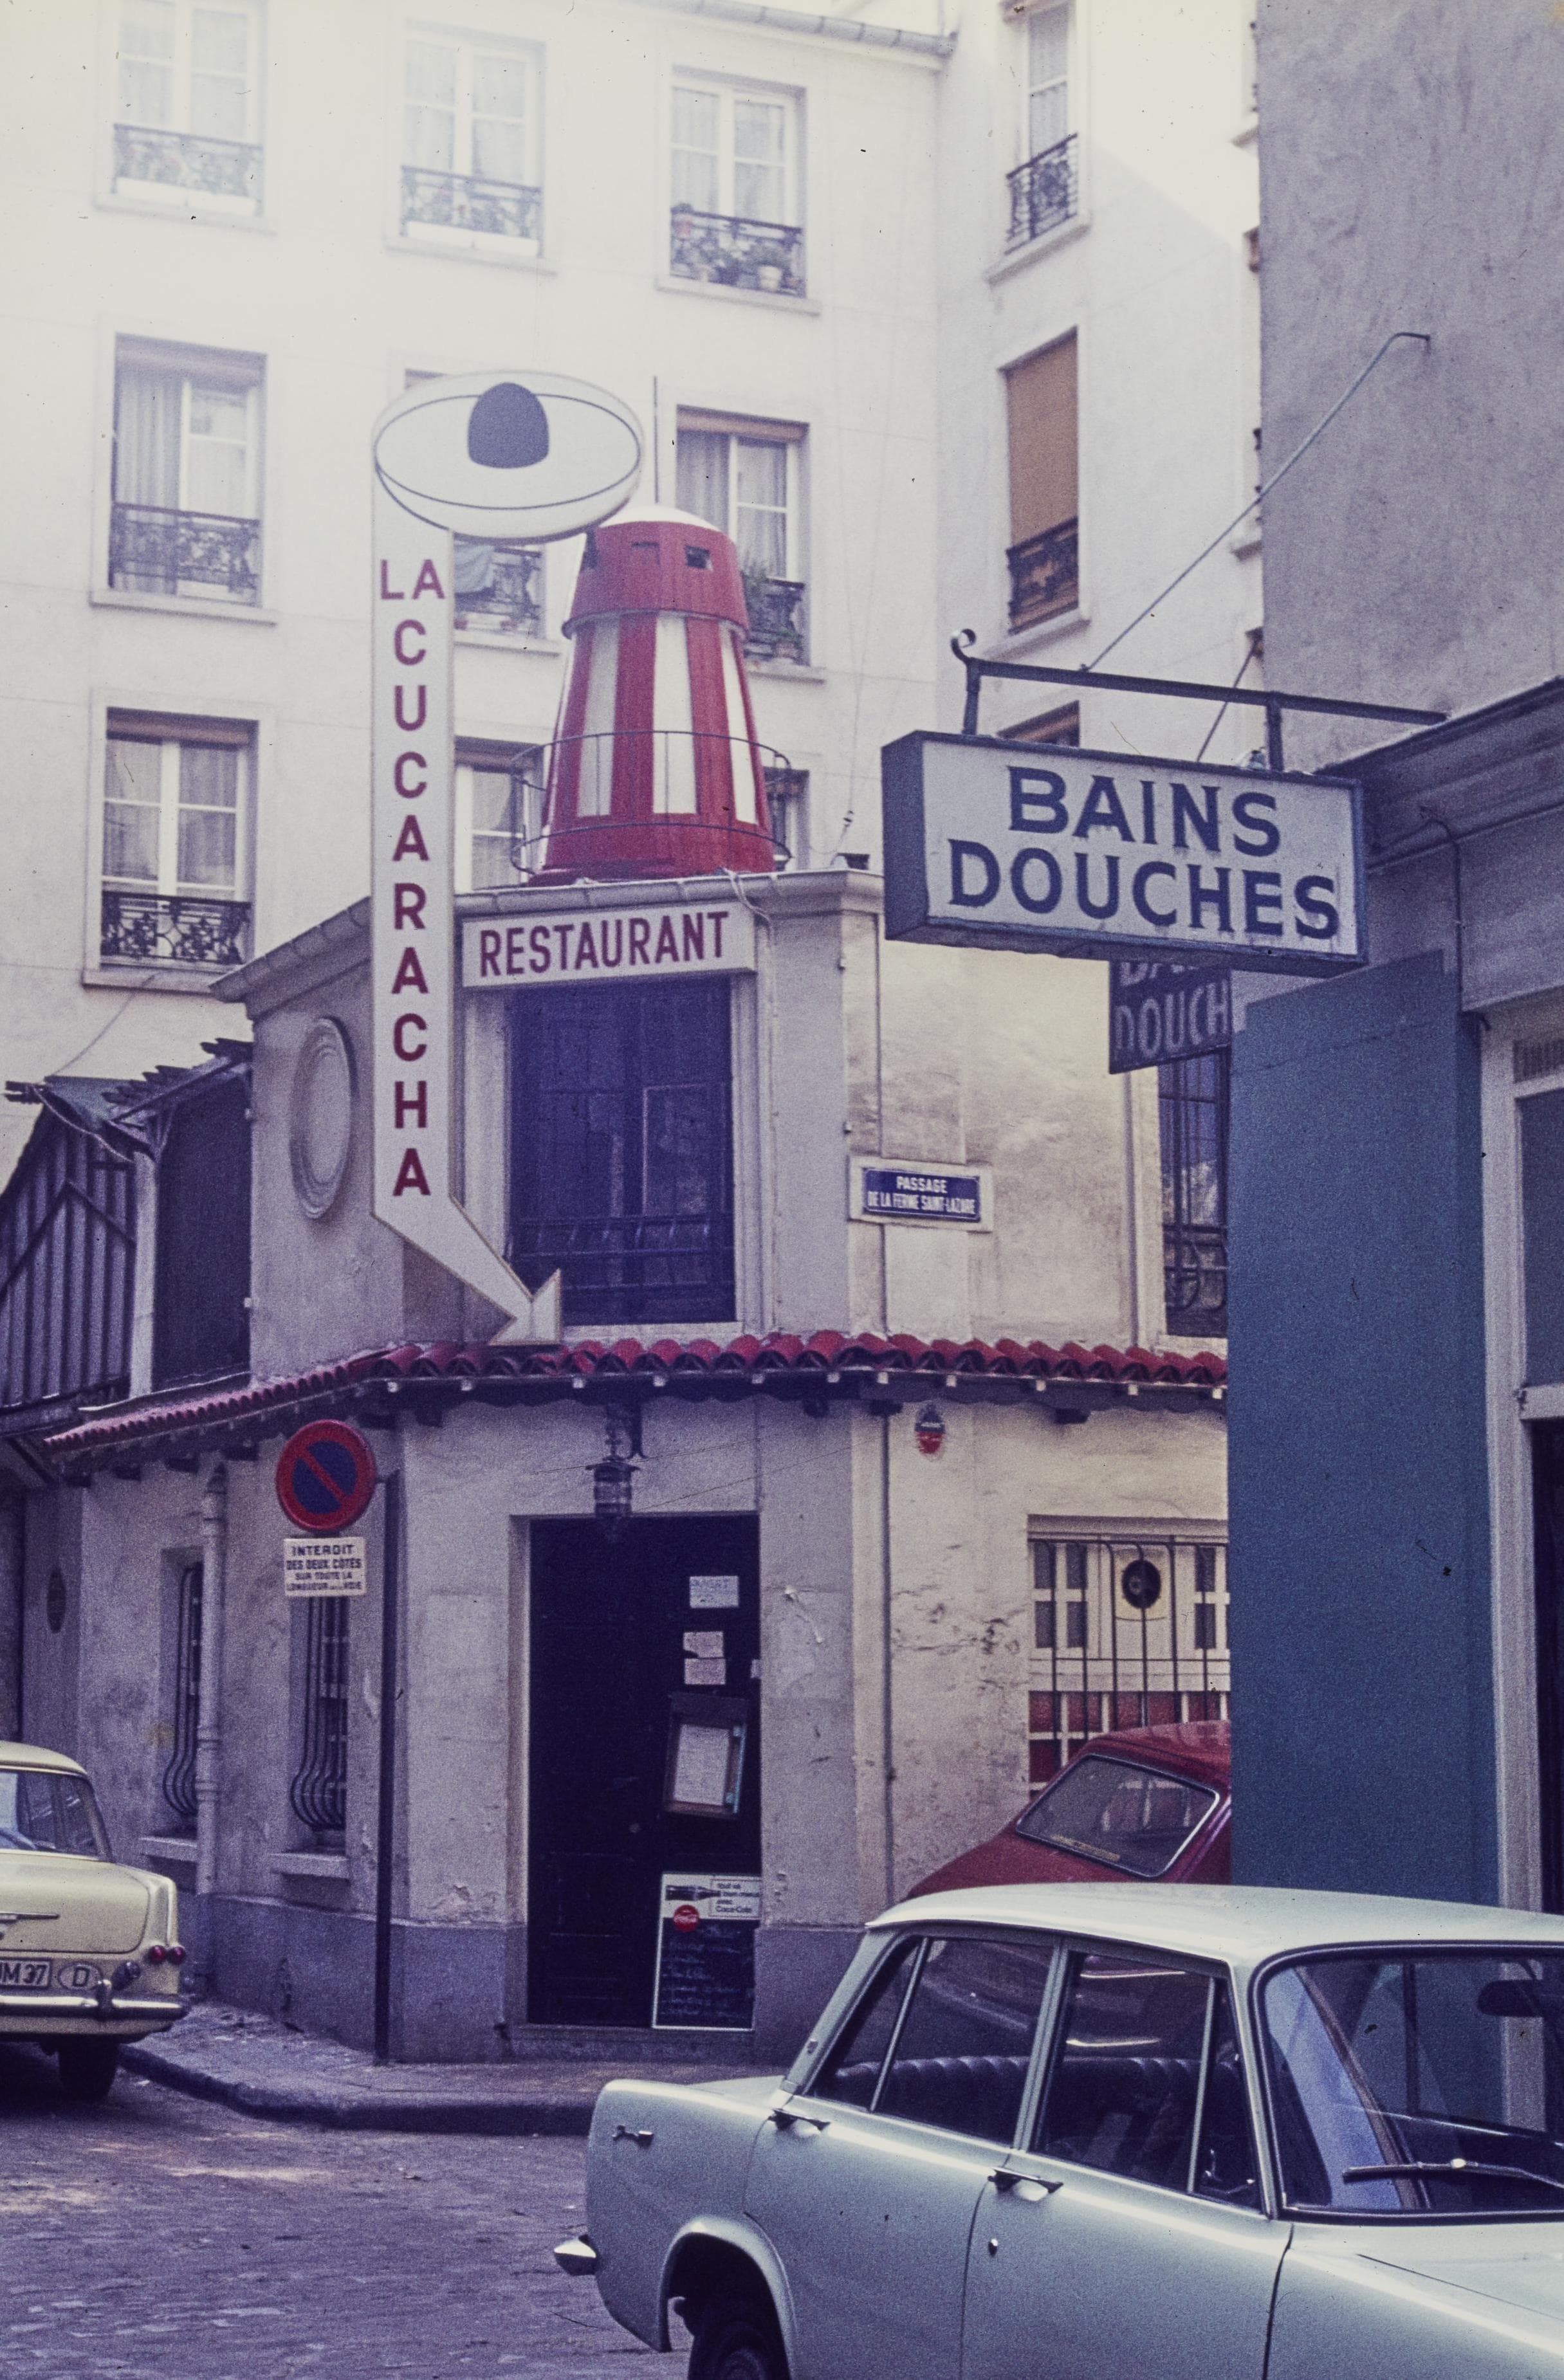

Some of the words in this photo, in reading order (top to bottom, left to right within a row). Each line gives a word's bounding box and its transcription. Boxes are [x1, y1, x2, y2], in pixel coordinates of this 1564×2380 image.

[380, 558, 445, 600] LA
[1006, 765, 1282, 857] BAINS
[947, 839, 1340, 940] DOUCHES
[391, 619, 430, 1196] CUCARACHA
[479, 911, 730, 978] RESTAURANT
[1114, 978, 1229, 1059] DOUCH
[868, 1191, 879, 1207] DE
[880, 1192, 892, 1208] LA
[892, 1193, 919, 1210] FERME
[896, 1176, 948, 1194] PASSAGE
[286, 1560, 304, 1570] DES
[306, 1559, 329, 1570] DEUX
[291, 1544, 355, 1555] INTERDIT
[23, 1964, 47, 1985] 37
[72, 1966, 90, 1987] D
